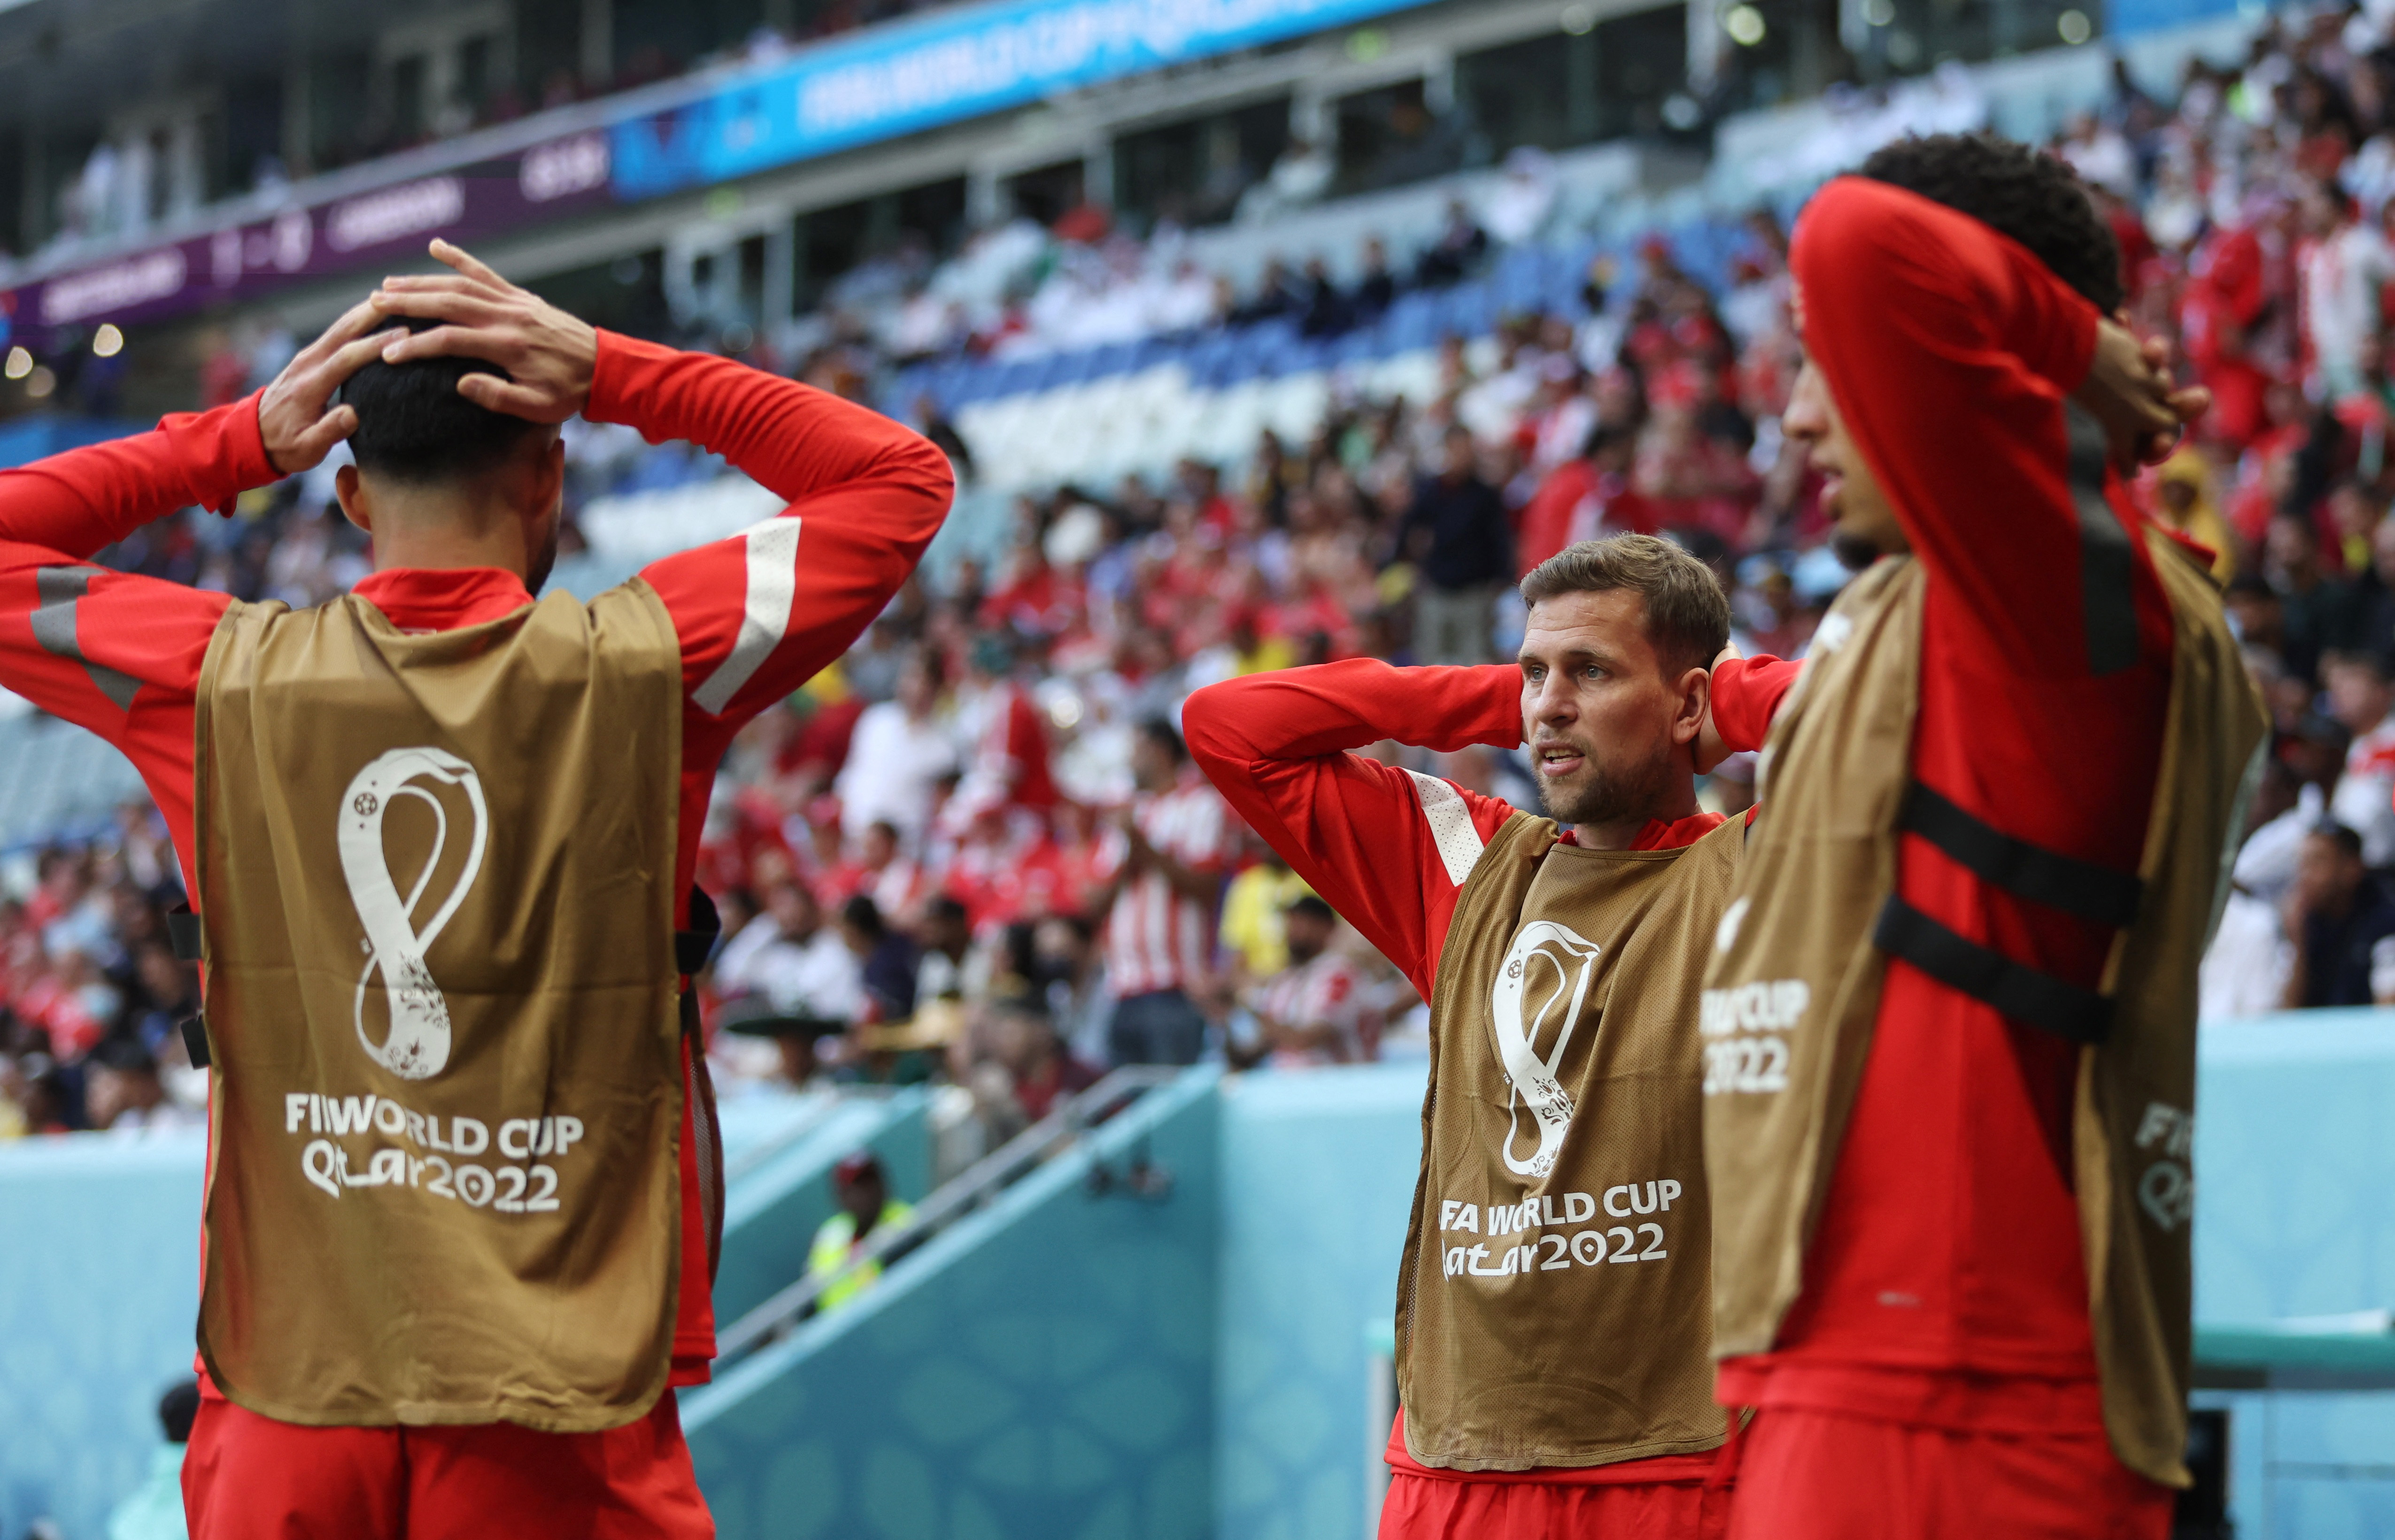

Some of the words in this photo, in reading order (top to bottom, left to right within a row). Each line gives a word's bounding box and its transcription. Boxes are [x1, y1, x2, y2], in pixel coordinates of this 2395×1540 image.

[1503, 1072, 1511, 1085] TM
[328, 1093, 489, 1156] WORLD
[497, 1115, 584, 1160] CUP
[1603, 1178, 1682, 1217] CUP
